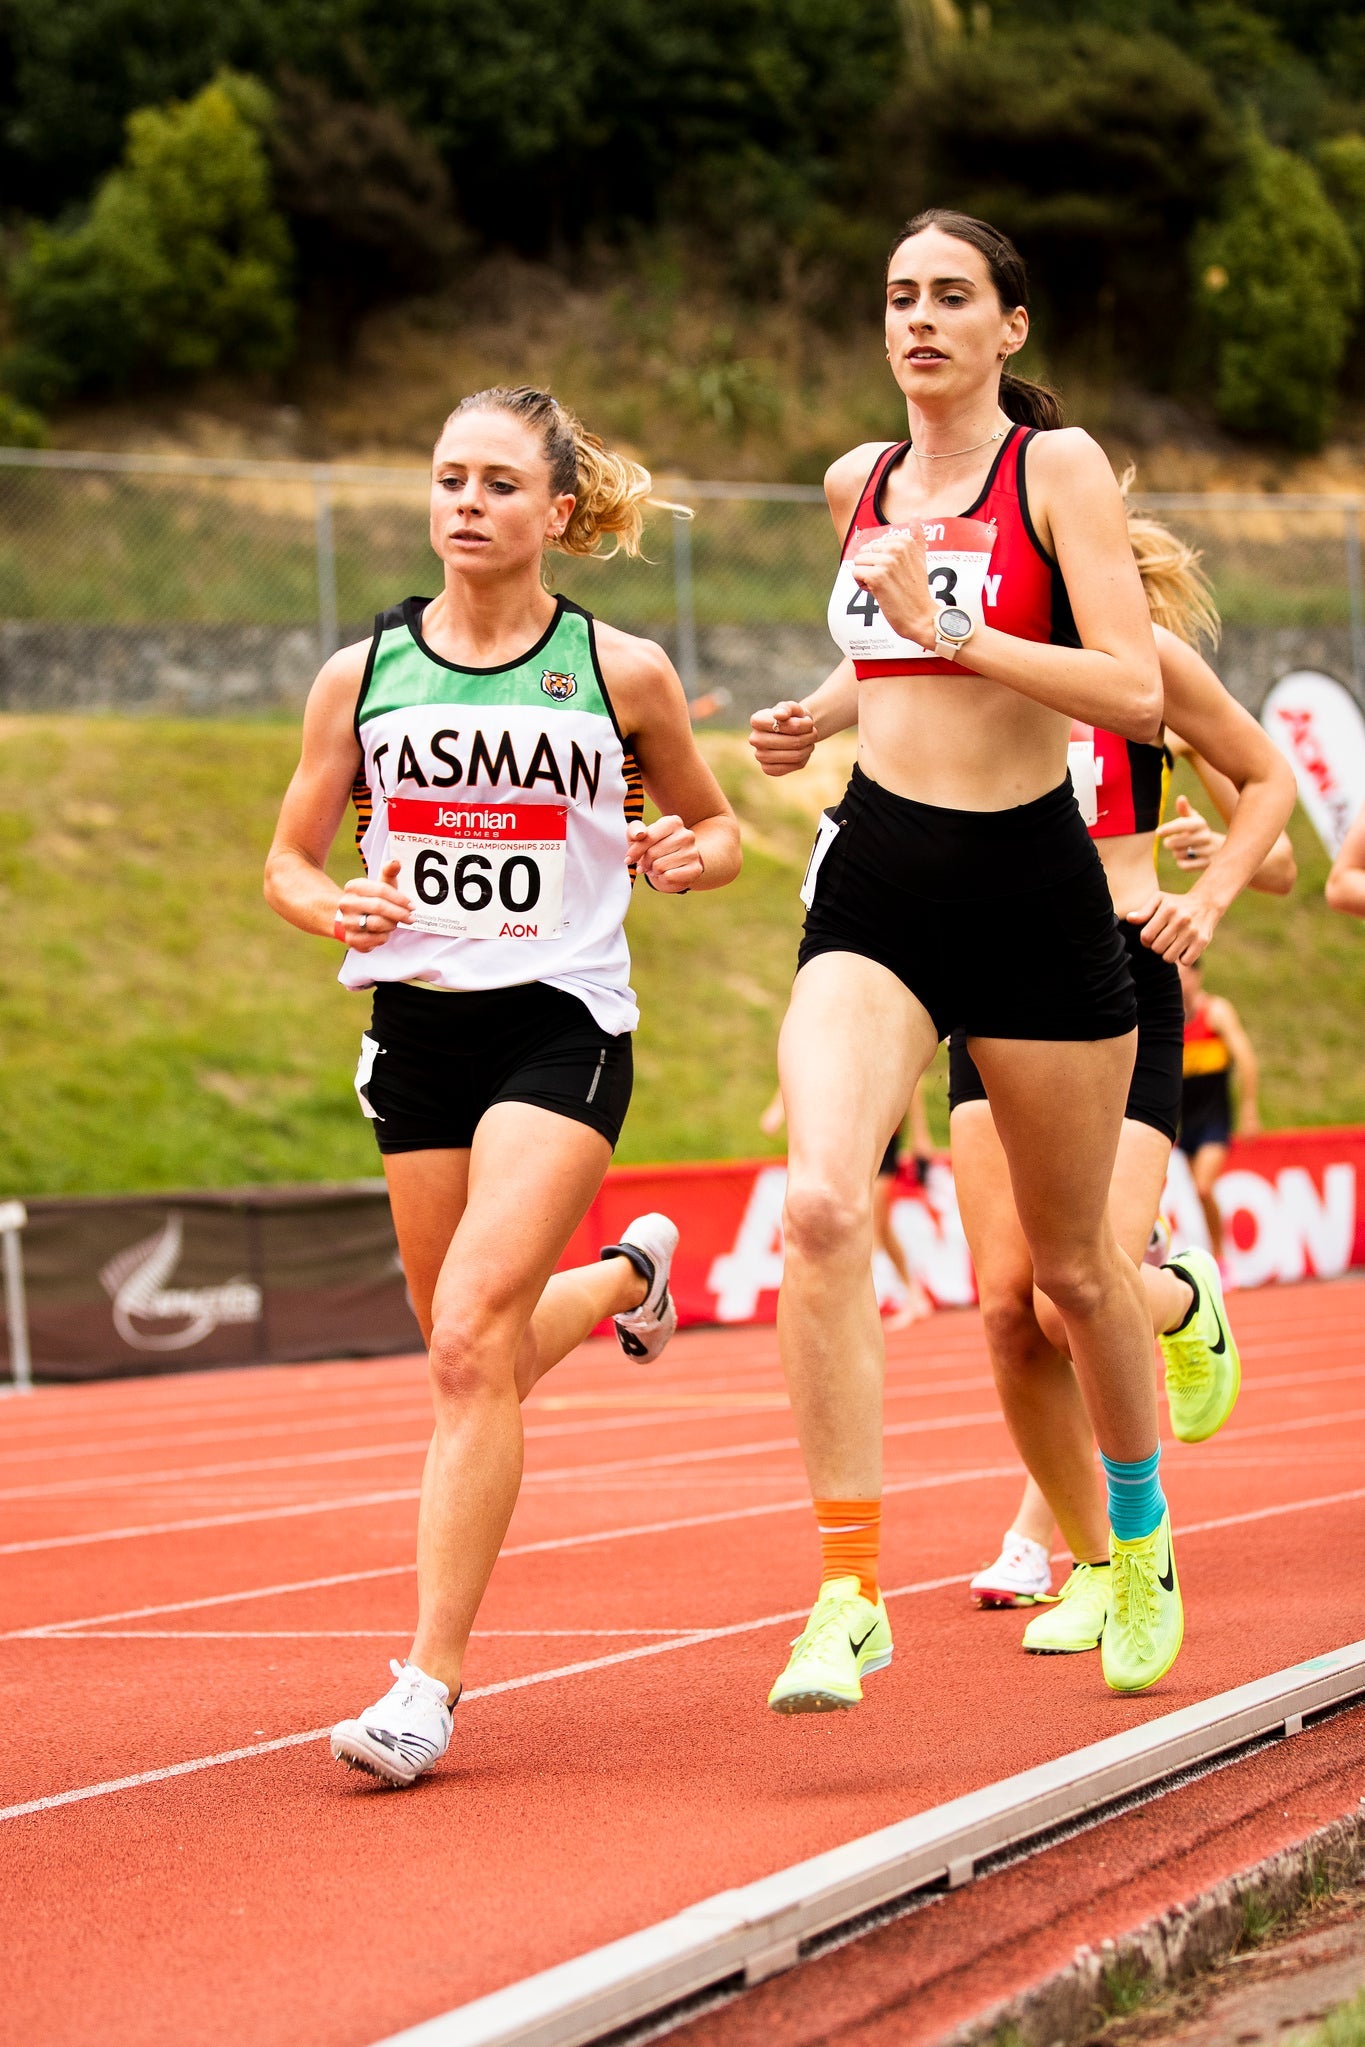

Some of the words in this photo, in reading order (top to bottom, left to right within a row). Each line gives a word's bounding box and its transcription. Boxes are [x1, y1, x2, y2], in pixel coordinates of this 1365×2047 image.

[846, 567, 958, 627] 43
[373, 729, 602, 812] TASMAN
[434, 807, 516, 830] Jennian
[454, 830, 500, 838] HOMES
[394, 834, 405, 843] NZ
[407, 835, 433, 845] TRACK
[441, 840, 464, 849] FIELD
[466, 842, 538, 851] CHAMPIONSHIPS
[539, 843, 561, 851] 2023
[413, 849, 541, 913] 660
[499, 922, 538, 938] AON
[707, 1165, 978, 1322] AN
